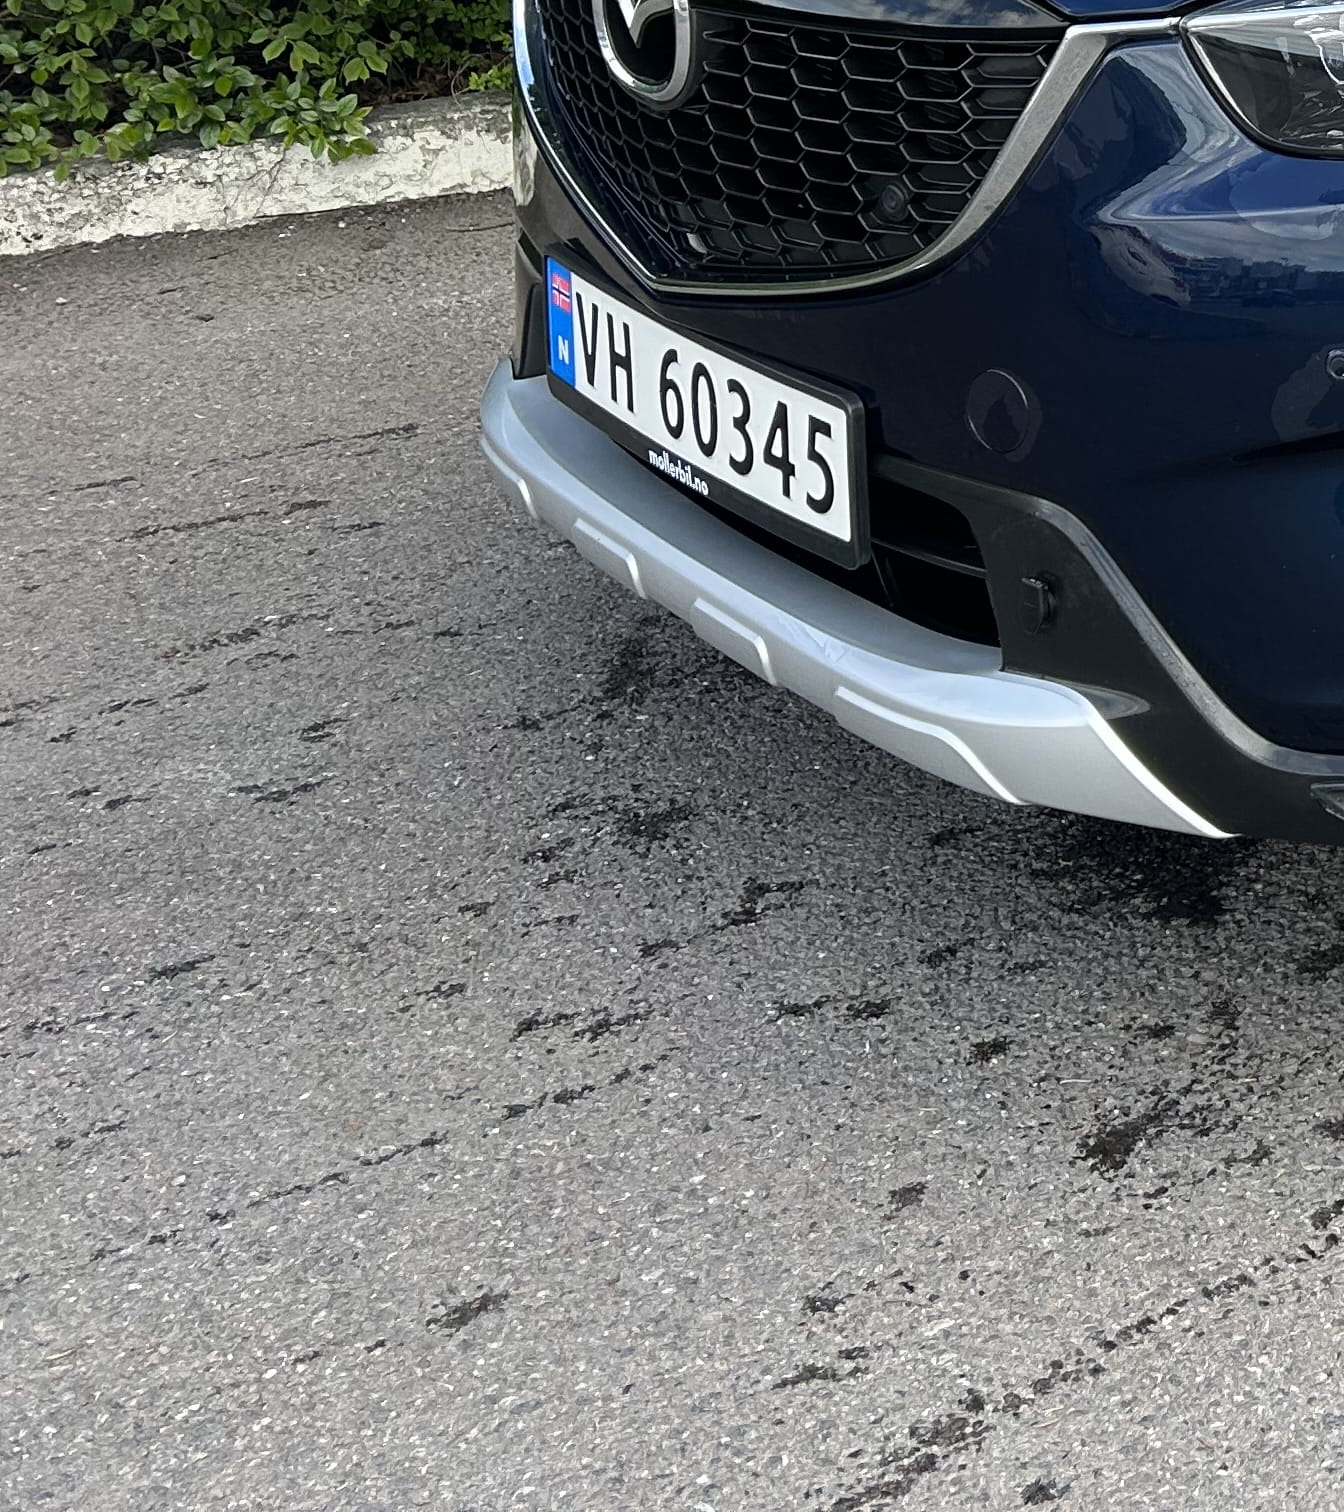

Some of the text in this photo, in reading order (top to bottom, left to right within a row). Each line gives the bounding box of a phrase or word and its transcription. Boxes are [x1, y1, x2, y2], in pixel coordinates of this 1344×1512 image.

[557, 335, 569, 365] N
[575, 291, 835, 514] VH 60345
